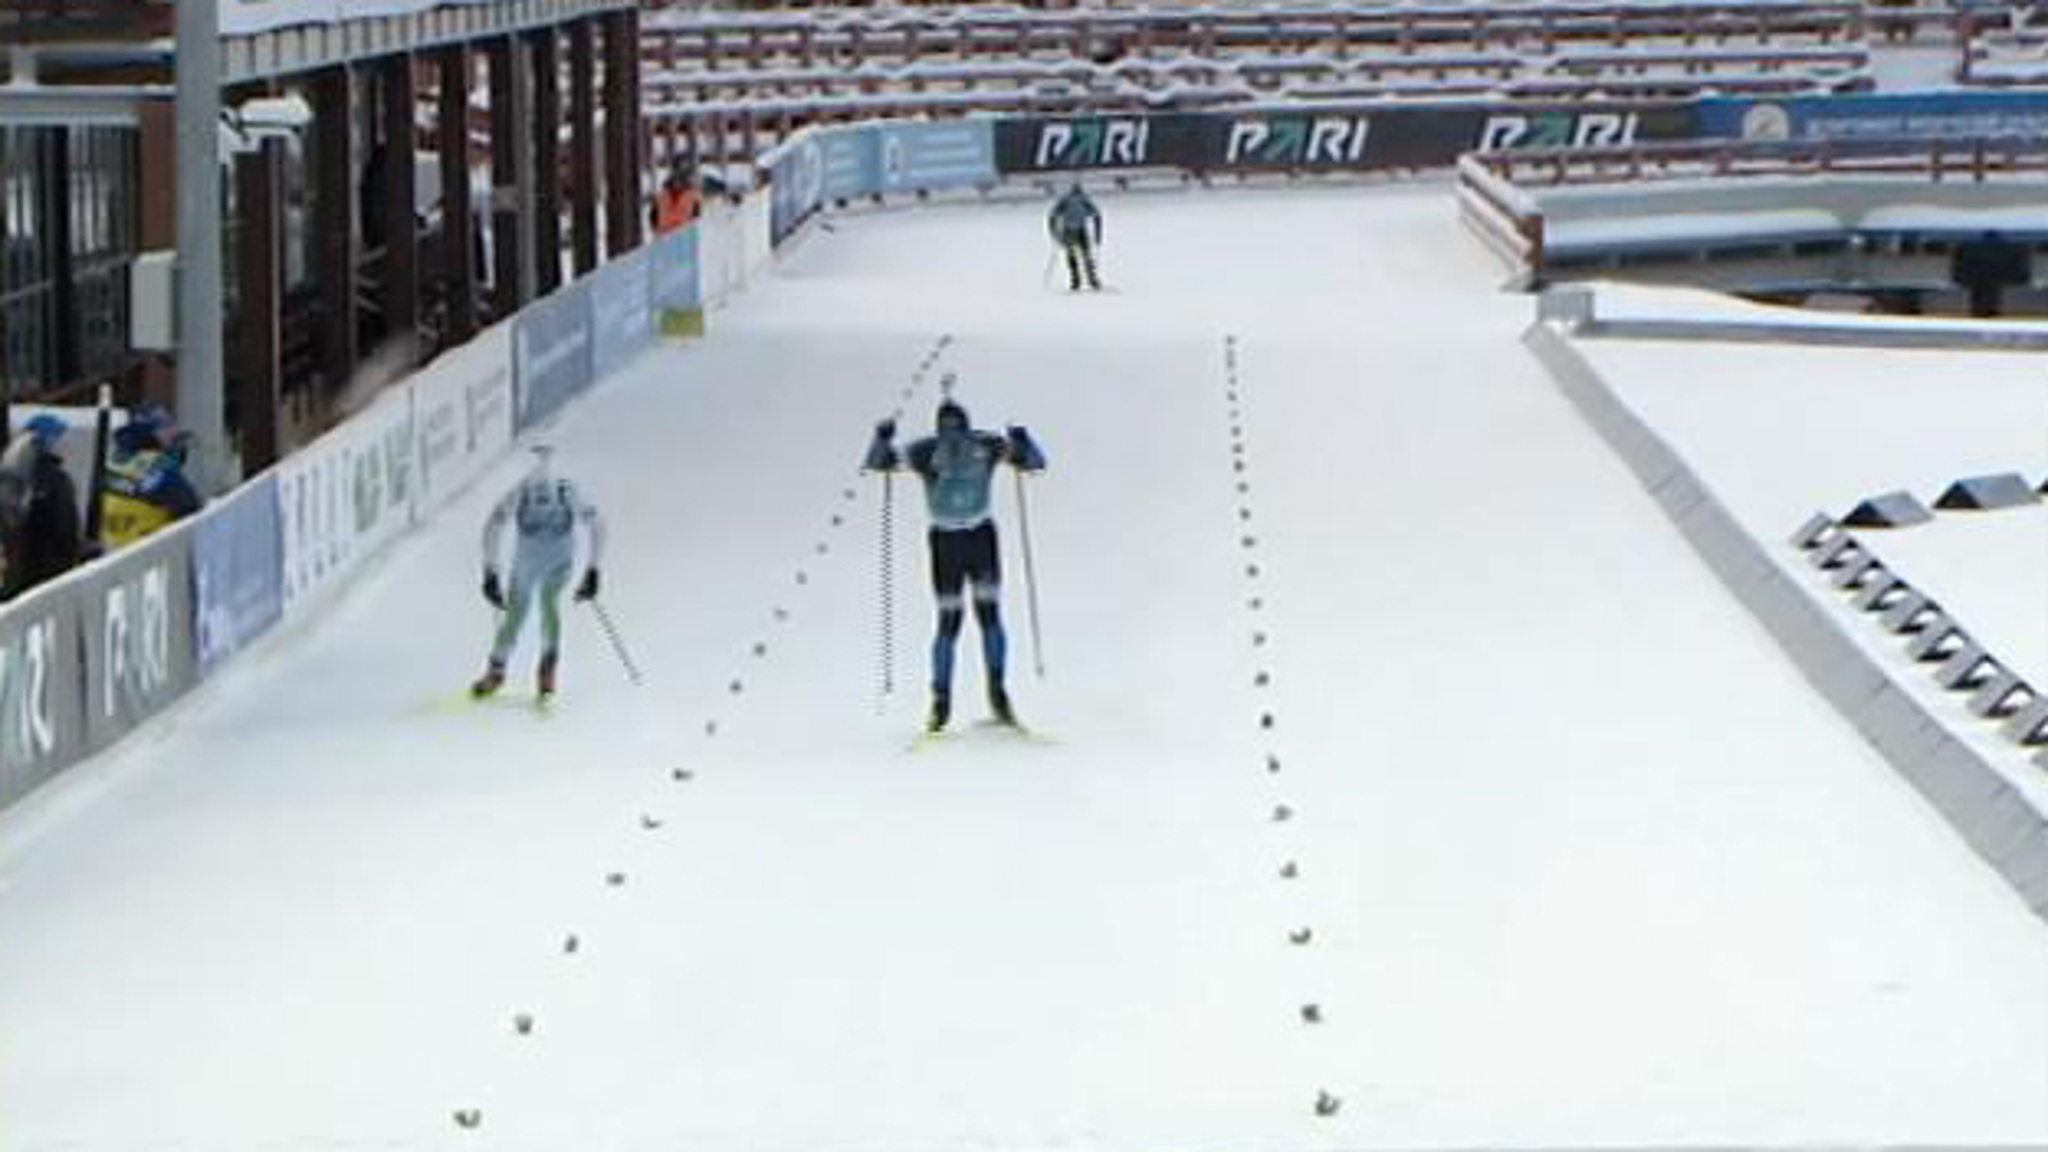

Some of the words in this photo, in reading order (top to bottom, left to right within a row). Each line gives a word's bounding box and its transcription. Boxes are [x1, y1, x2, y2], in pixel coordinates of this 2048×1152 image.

[1036, 116, 1149, 165] PARI
[1226, 117, 1369, 163] PARI
[1478, 111, 1638, 154] PARI
